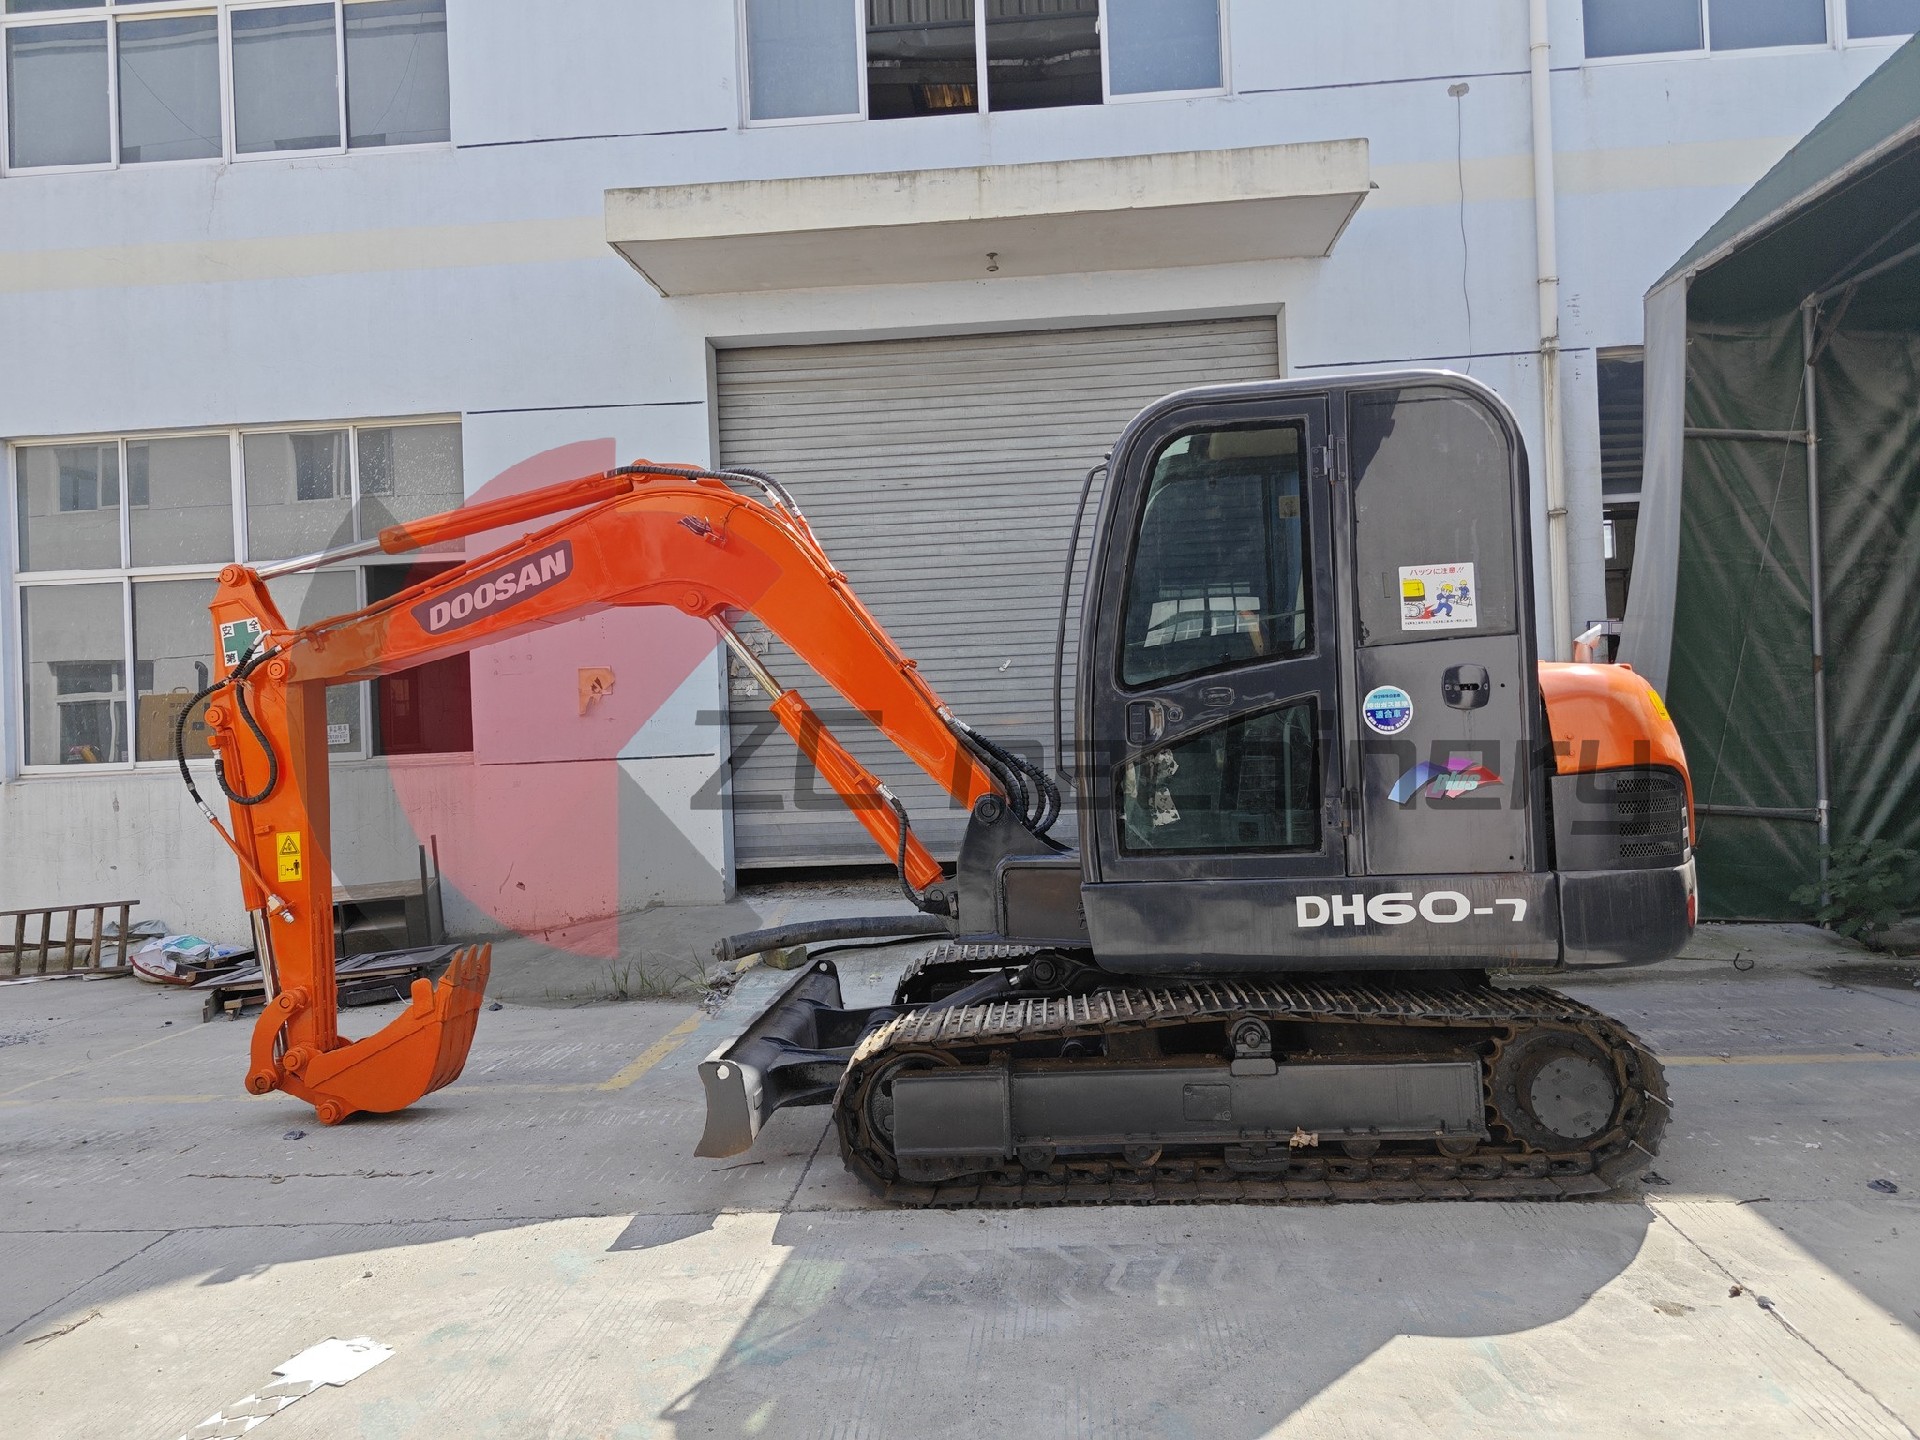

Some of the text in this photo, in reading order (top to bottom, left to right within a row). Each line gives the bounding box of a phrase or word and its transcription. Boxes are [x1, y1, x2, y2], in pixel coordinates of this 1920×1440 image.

[429, 549, 567, 632] DOOSAN
[1431, 771, 1481, 794] plus
[1295, 890, 1528, 928] DH60-7
